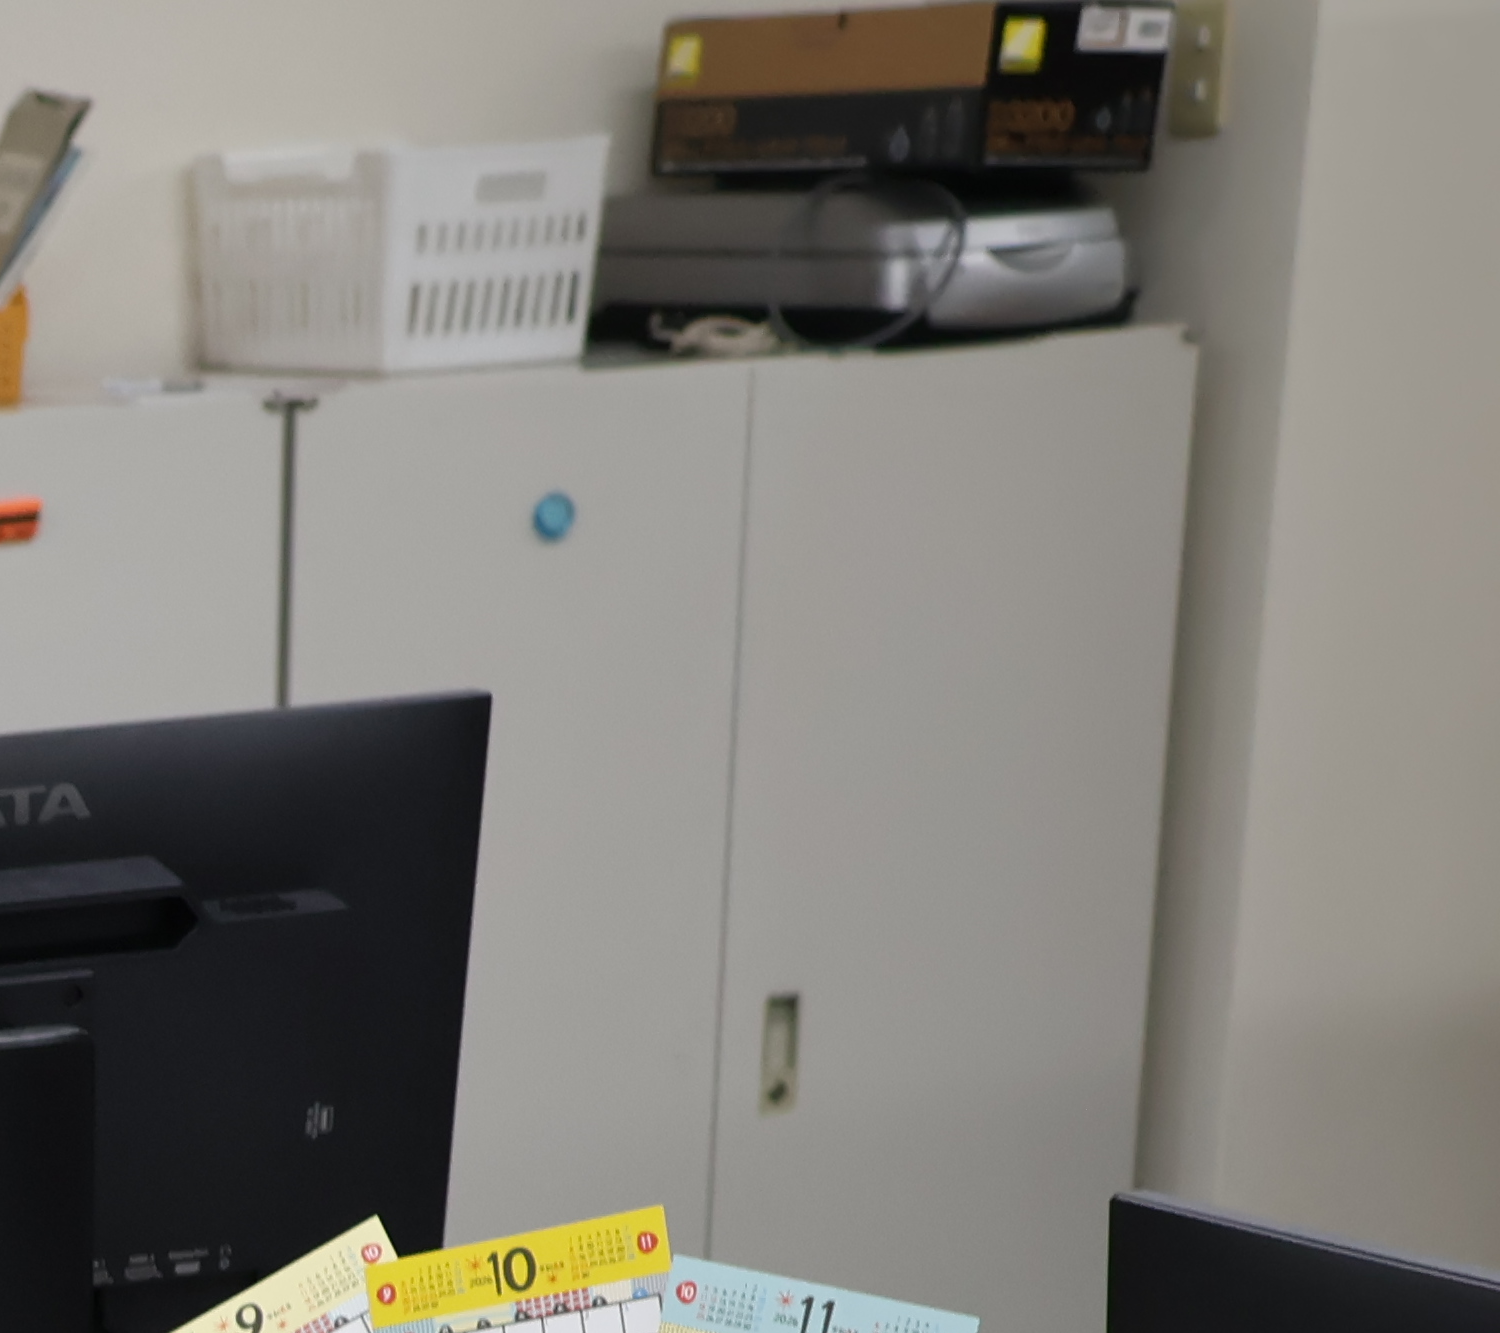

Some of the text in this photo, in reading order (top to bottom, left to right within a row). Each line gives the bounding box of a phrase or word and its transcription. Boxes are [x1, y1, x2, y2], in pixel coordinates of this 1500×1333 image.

[640, 1235, 655, 1251] 11
[364, 1245, 380, 1261] 10
[487, 1247, 537, 1296] 10
[382, 1288, 392, 1301] 9
[680, 1286, 694, 1300] 10
